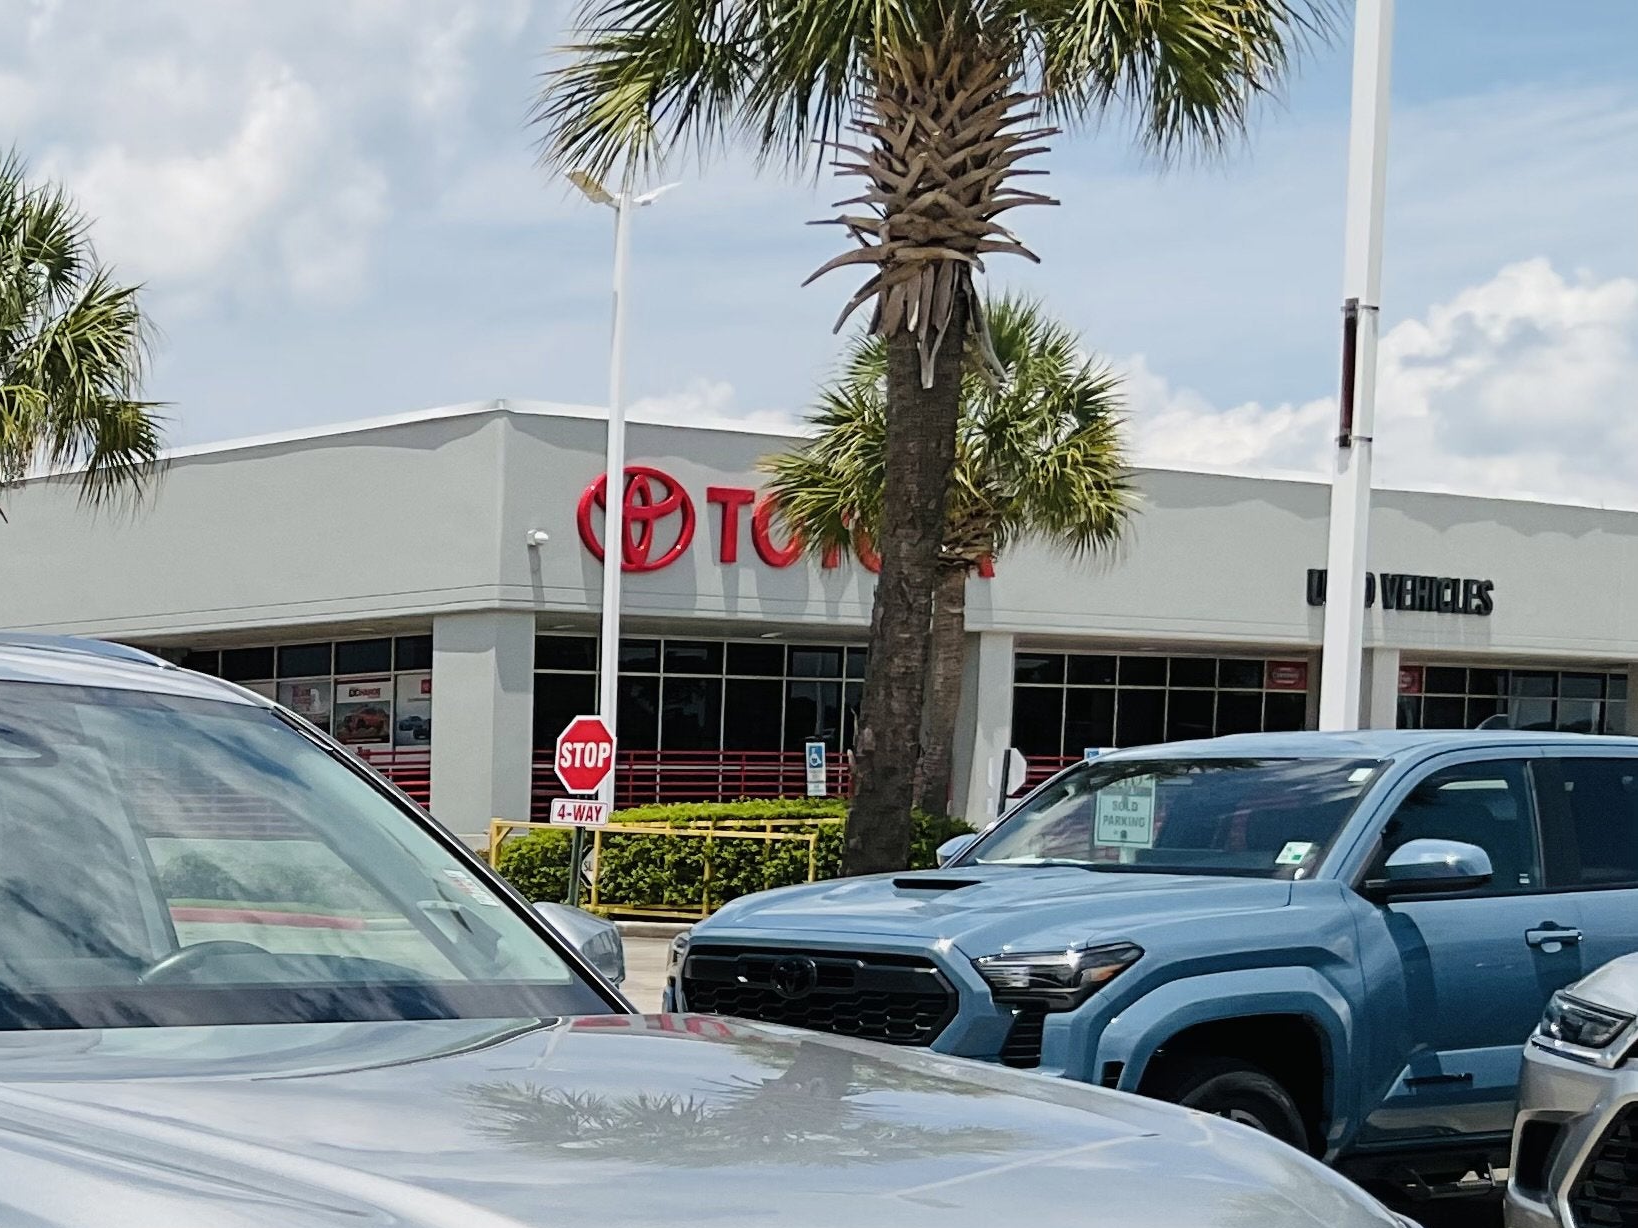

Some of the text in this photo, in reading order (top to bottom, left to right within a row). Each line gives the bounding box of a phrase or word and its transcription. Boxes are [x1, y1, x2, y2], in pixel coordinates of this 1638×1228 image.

[1380, 573, 1494, 616] VEHICLES
[560, 741, 611, 769] STOP
[556, 803, 603, 823] 4-WAY
[1112, 800, 1138, 812] SOLD
[1102, 815, 1146, 828] PARKING
